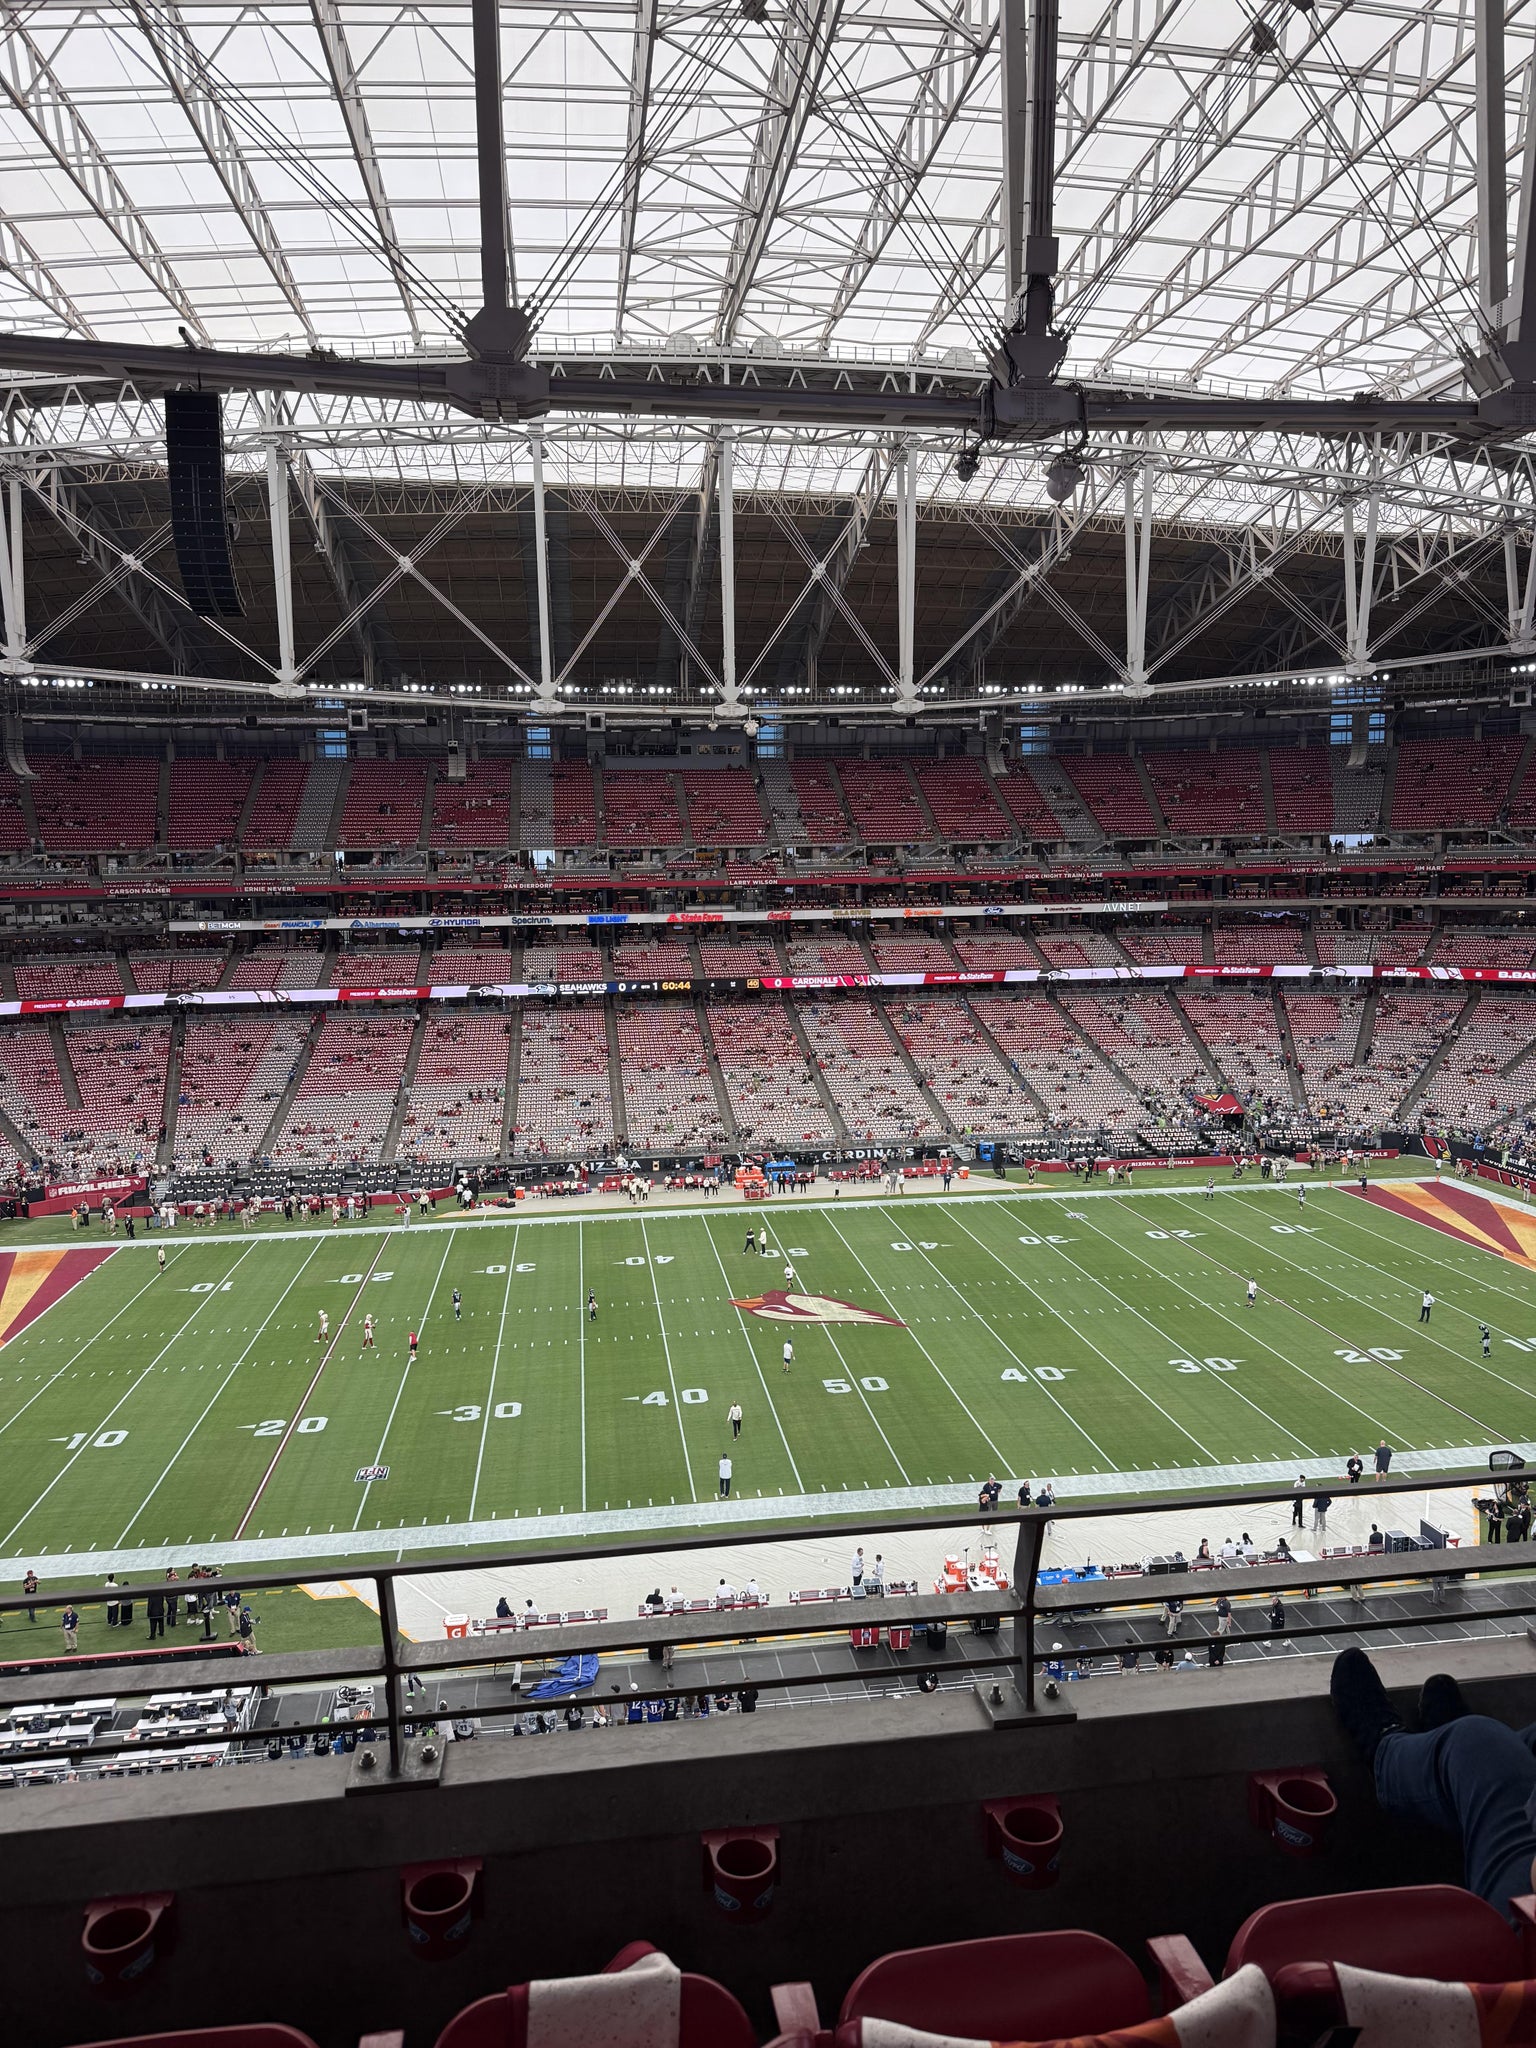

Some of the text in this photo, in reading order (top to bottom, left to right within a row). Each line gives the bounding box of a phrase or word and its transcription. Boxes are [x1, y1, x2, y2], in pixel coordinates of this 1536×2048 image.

[850, 908, 872, 916] RIVER
[1102, 902, 1142, 912] AVNET
[207, 921, 241, 930] BETMGM
[280, 921, 310, 929] FINANCIAL
[363, 920, 401, 929] Albertsons
[443, 918, 481, 926] HYUNDAI
[511, 916, 550, 926] Spectrum
[661, 981, 692, 991] 60:44
[774, 978, 782, 988] 0
[791, 976, 839, 986] CARDINALS
[559, 982, 608, 992] SEAHAWKS
[618, 982, 627, 992] 0
[57, 1179, 132, 1196] RIVALRIES
[1144, 1229, 1198, 1240] 20
[1269, 1224, 1315, 1235] 10
[1018, 1234, 1069, 1245] 30
[890, 1240, 939, 1251] 40
[625, 1254, 675, 1266] 40
[486, 1262, 537, 1275] 30
[339, 1271, 395, 1284] 20
[189, 1281, 235, 1293] 10
[1333, 1347, 1404, 1364] 20
[1167, 1356, 1239, 1374] 30
[1000, 1366, 1067, 1384] 40
[821, 1376, 890, 1394] 50
[641, 1388, 709, 1407] 40
[452, 1402, 523, 1422] 30
[253, 1416, 329, 1437] 20
[65, 1430, 130, 1450] 10
[451, 1627, 462, 1639] G
[1049, 1660, 1059, 1670] 25
[631, 1700, 641, 1710] 12
[668, 1700, 675, 1711] 3
[404, 1724, 413, 1734] 51
[1277, 1822, 1304, 1843] Ford
